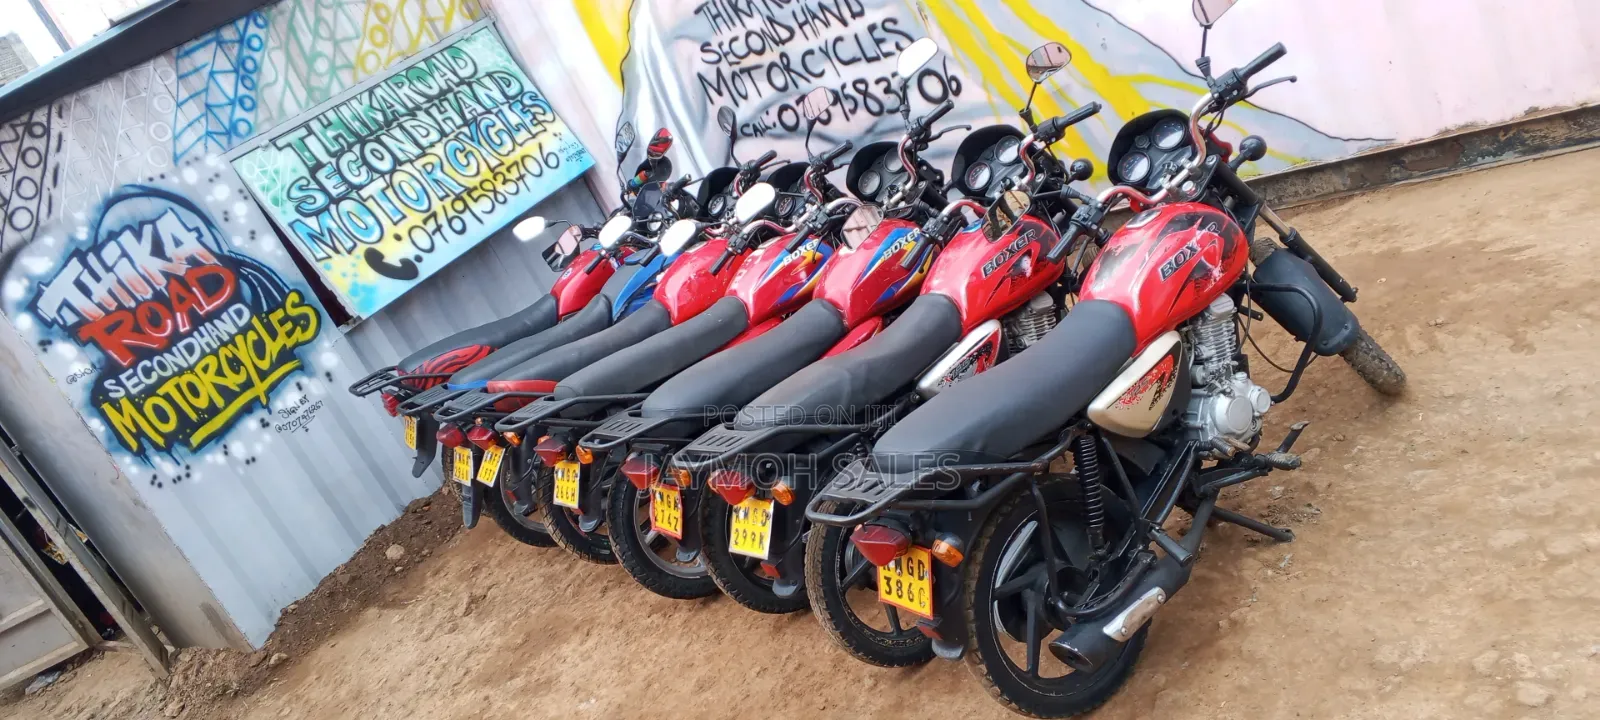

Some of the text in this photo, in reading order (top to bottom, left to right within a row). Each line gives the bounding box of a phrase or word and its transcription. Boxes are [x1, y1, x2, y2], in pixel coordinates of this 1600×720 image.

[697, 17, 916, 107] MOTORCYCLES
[289, 91, 555, 261] MOTORCYCLES
[34, 207, 223, 328] THIKA
[783, 238, 819, 266] BOXER
[883, 227, 921, 261] BOXER
[982, 228, 1037, 278] BOXER
[77, 263, 236, 366] ROAD
[100, 290, 319, 452] MOTORCYCLES
[734, 528, 764, 551] 299K
